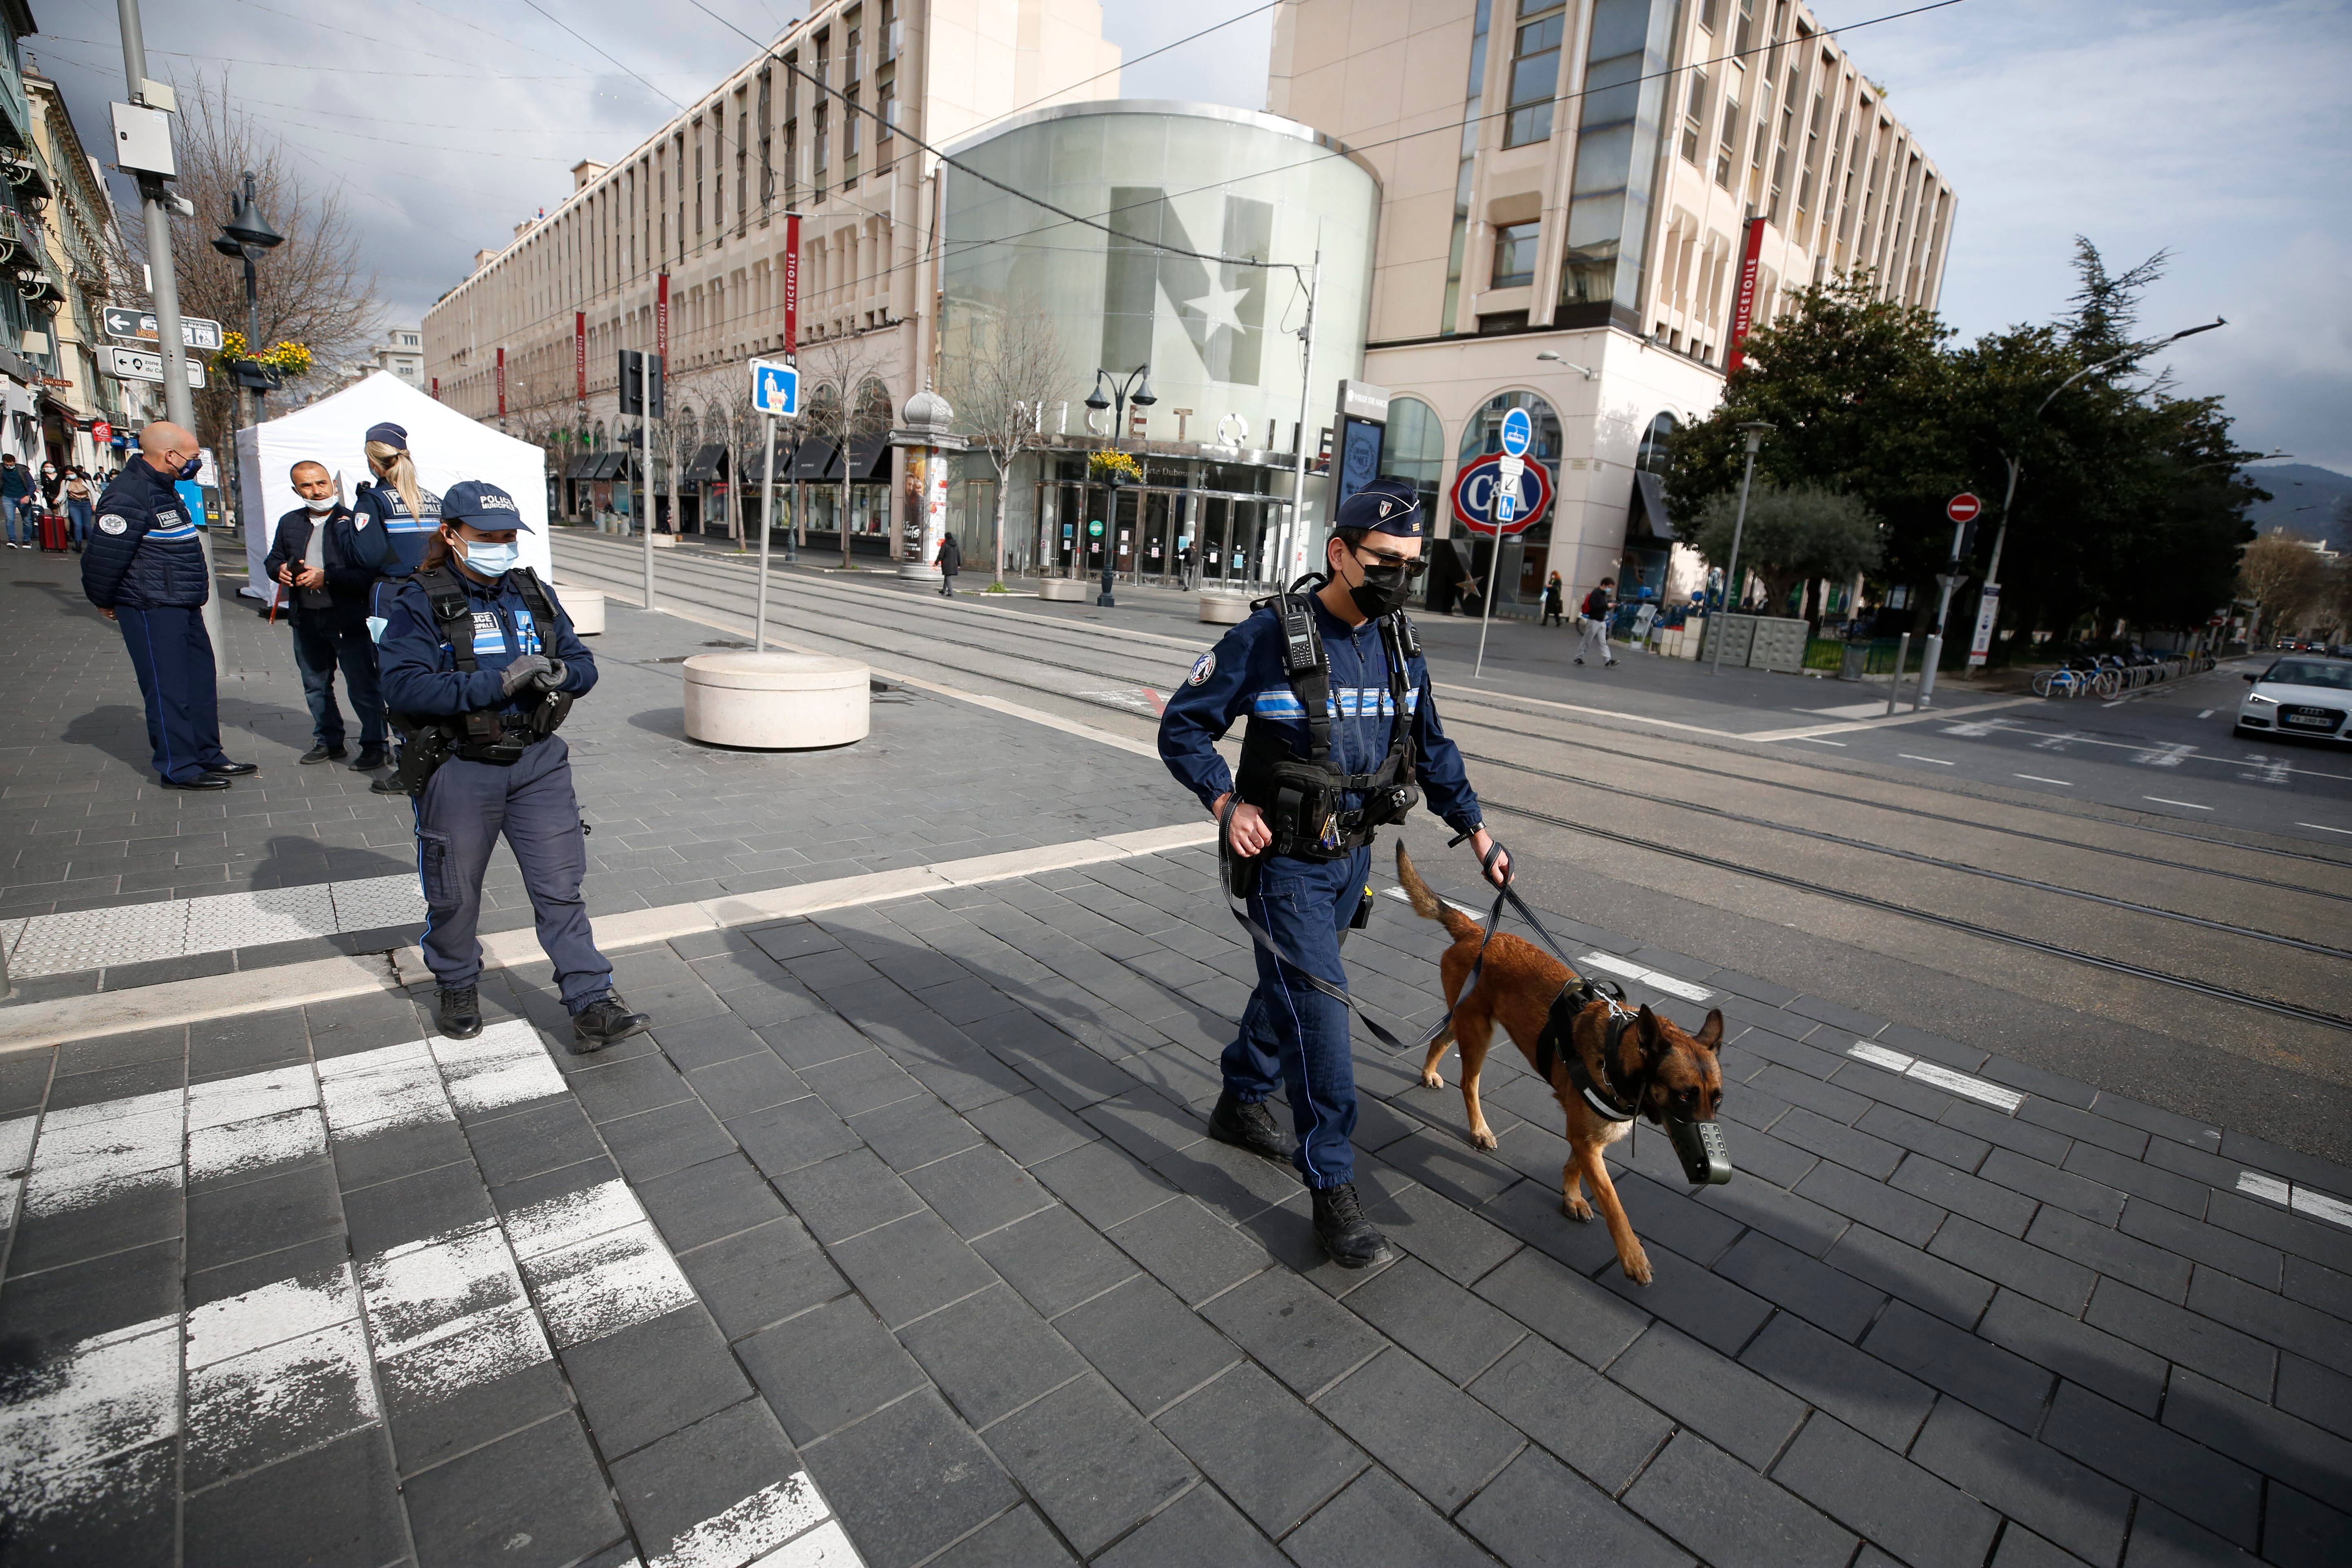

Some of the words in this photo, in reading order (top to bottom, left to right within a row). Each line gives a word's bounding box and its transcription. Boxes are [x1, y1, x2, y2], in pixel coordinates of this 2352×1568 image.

[787, 252, 796, 311] NICETOILE
[1737, 258, 1756, 330] NICETOILE
[1354, 393, 1368, 403] VILLE
[1375, 399, 1388, 408] NICE
[480, 495, 513, 506] POLICE
[482, 503, 515, 512] MUNICIPALE
[160, 512, 178, 521] POLICE
